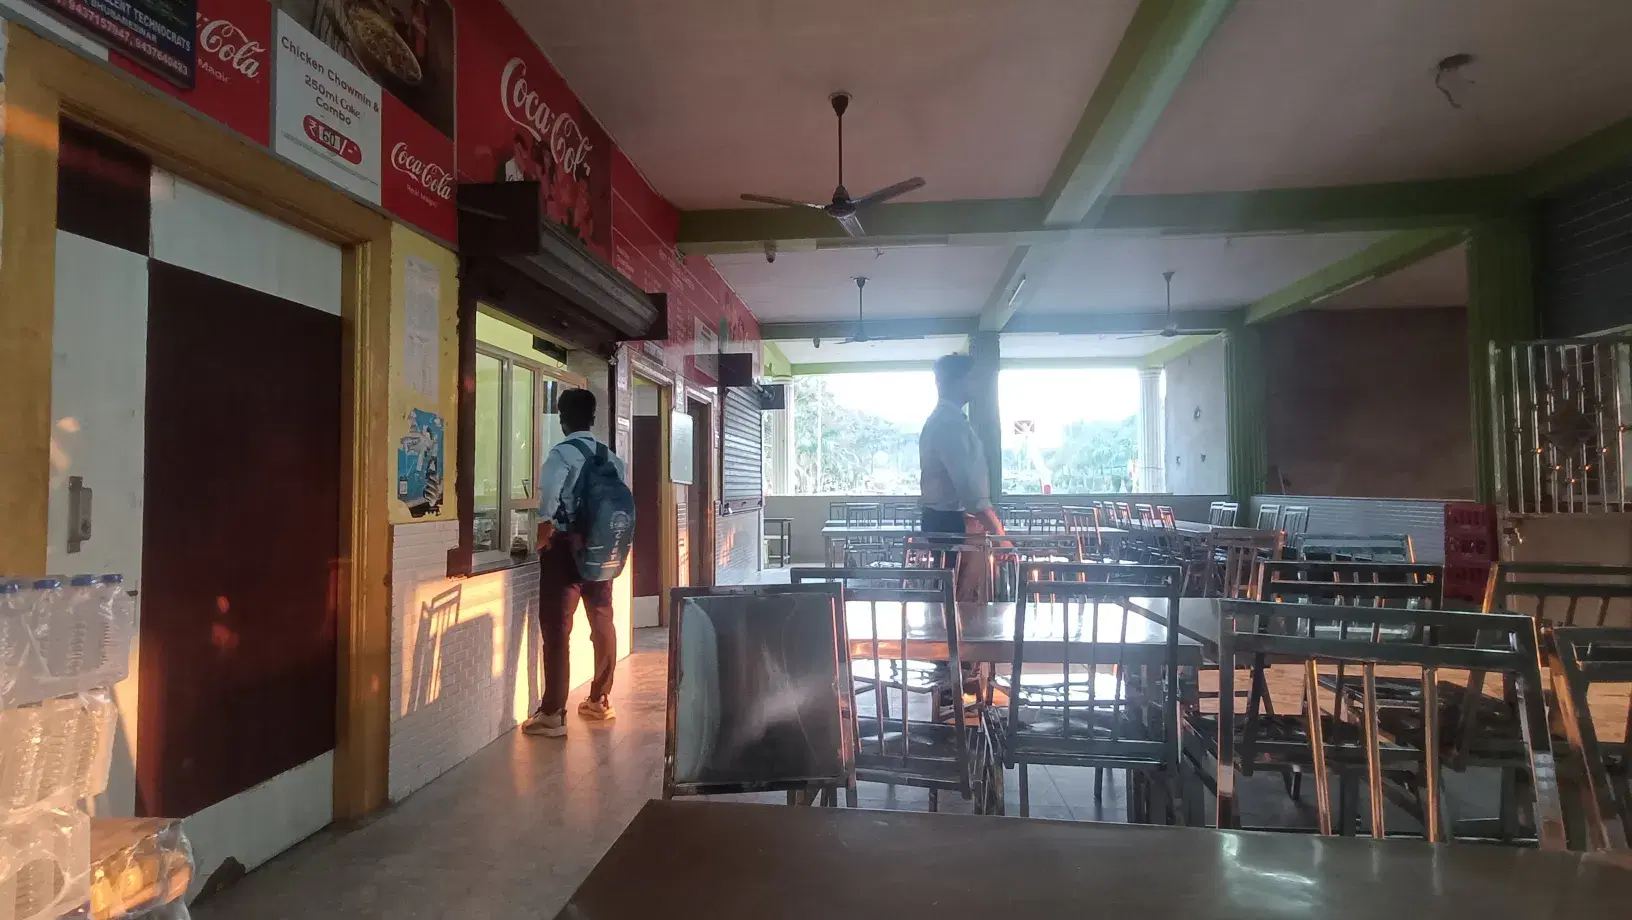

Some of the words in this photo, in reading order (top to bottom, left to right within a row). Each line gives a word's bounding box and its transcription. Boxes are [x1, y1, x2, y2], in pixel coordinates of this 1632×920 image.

[133, 8, 191, 52] TECHNOCRATS
[281, 36, 324, 74] Chicken
[327, 69, 372, 107] Chowmin
[373, 102, 380, 113] &
[304, 74, 339, 105] 250ml
[315, 96, 352, 125] Combo
[391, 141, 454, 199] Coca-Cola
